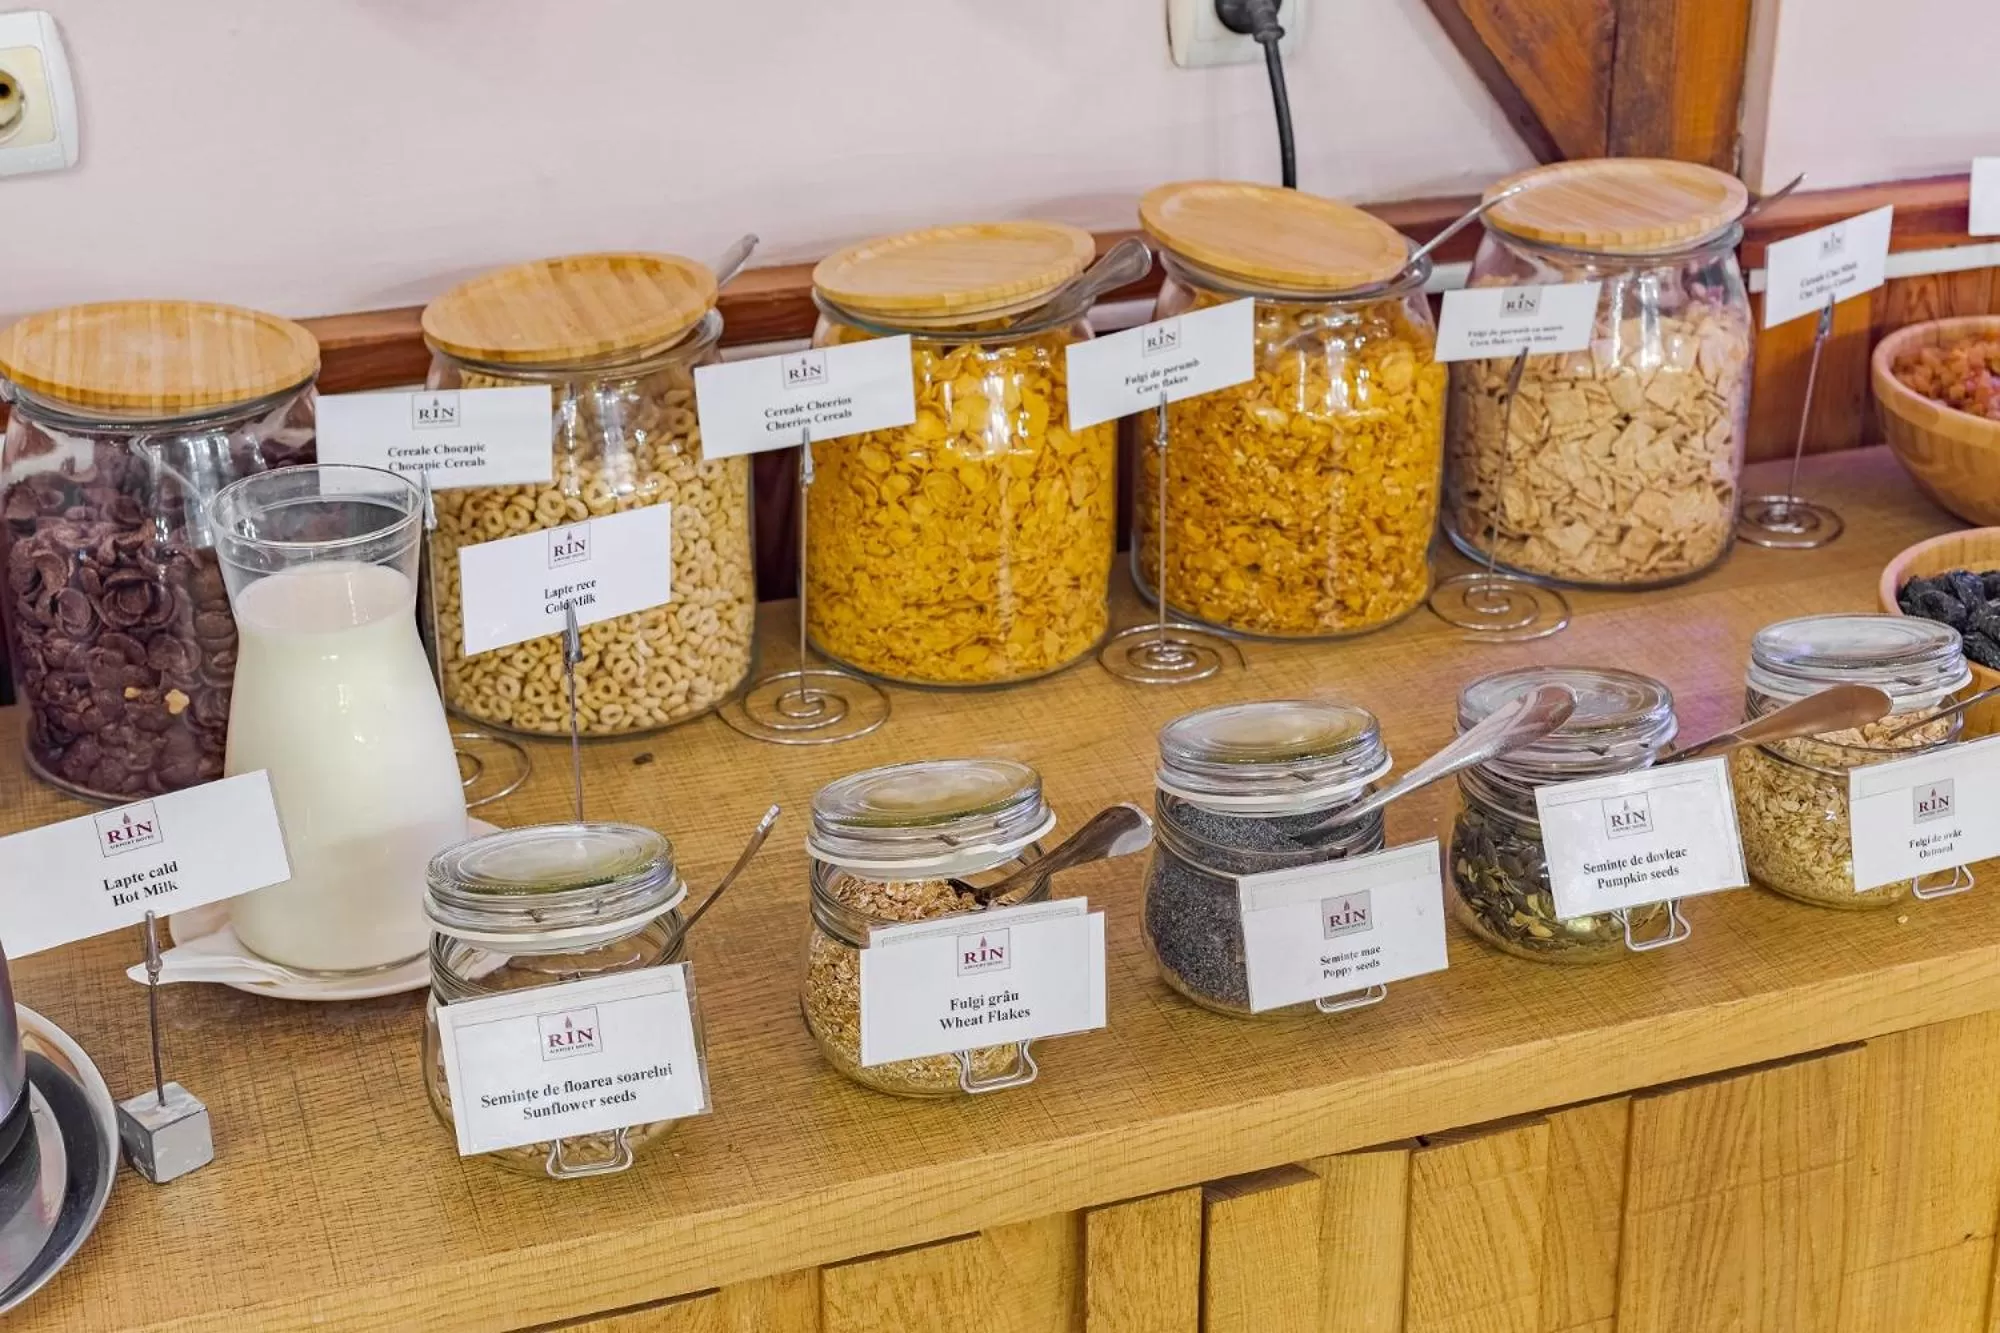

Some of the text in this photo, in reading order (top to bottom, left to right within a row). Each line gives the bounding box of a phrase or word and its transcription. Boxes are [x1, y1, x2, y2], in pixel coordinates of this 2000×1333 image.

[1147, 332, 1176, 347] RIN
[789, 365, 821, 379] RIN
[1150, 369, 1161, 379] de
[1136, 383, 1160, 394] Corn
[418, 407, 454, 420] RIN
[764, 396, 852, 418] Cereale Cheerios
[766, 409, 852, 431] Cheerios Cereals
[387, 443, 486, 457] Cereale Chocapic
[388, 456, 485, 471] Chocapic Cereals
[554, 540, 586, 557] RIN
[544, 579, 597, 599] Lapte rece
[1919, 795, 1950, 813] RIN
[1610, 810, 1646, 828] RIN
[107, 820, 153, 844] RIN
[1630, 855, 1644, 867] de
[1646, 848, 1688, 864] dovleac
[103, 861, 178, 891] Lapte cald
[1597, 865, 1680, 889] Pumpkin seeds
[112, 880, 179, 907] Hot Milk
[1329, 909, 1366, 927] RIN
[964, 947, 1004, 964] RIN
[1323, 959, 1381, 980] Poppy seeds
[950, 994, 984, 1010] Fulgi
[939, 1007, 1031, 1030] Wheat Flakes
[548, 1027, 594, 1048] RIN
[543, 1084, 560, 1097] de
[563, 1075, 613, 1093] floarea
[616, 1063, 673, 1082] soarelui
[523, 1090, 637, 1120] Sunflower seeds
